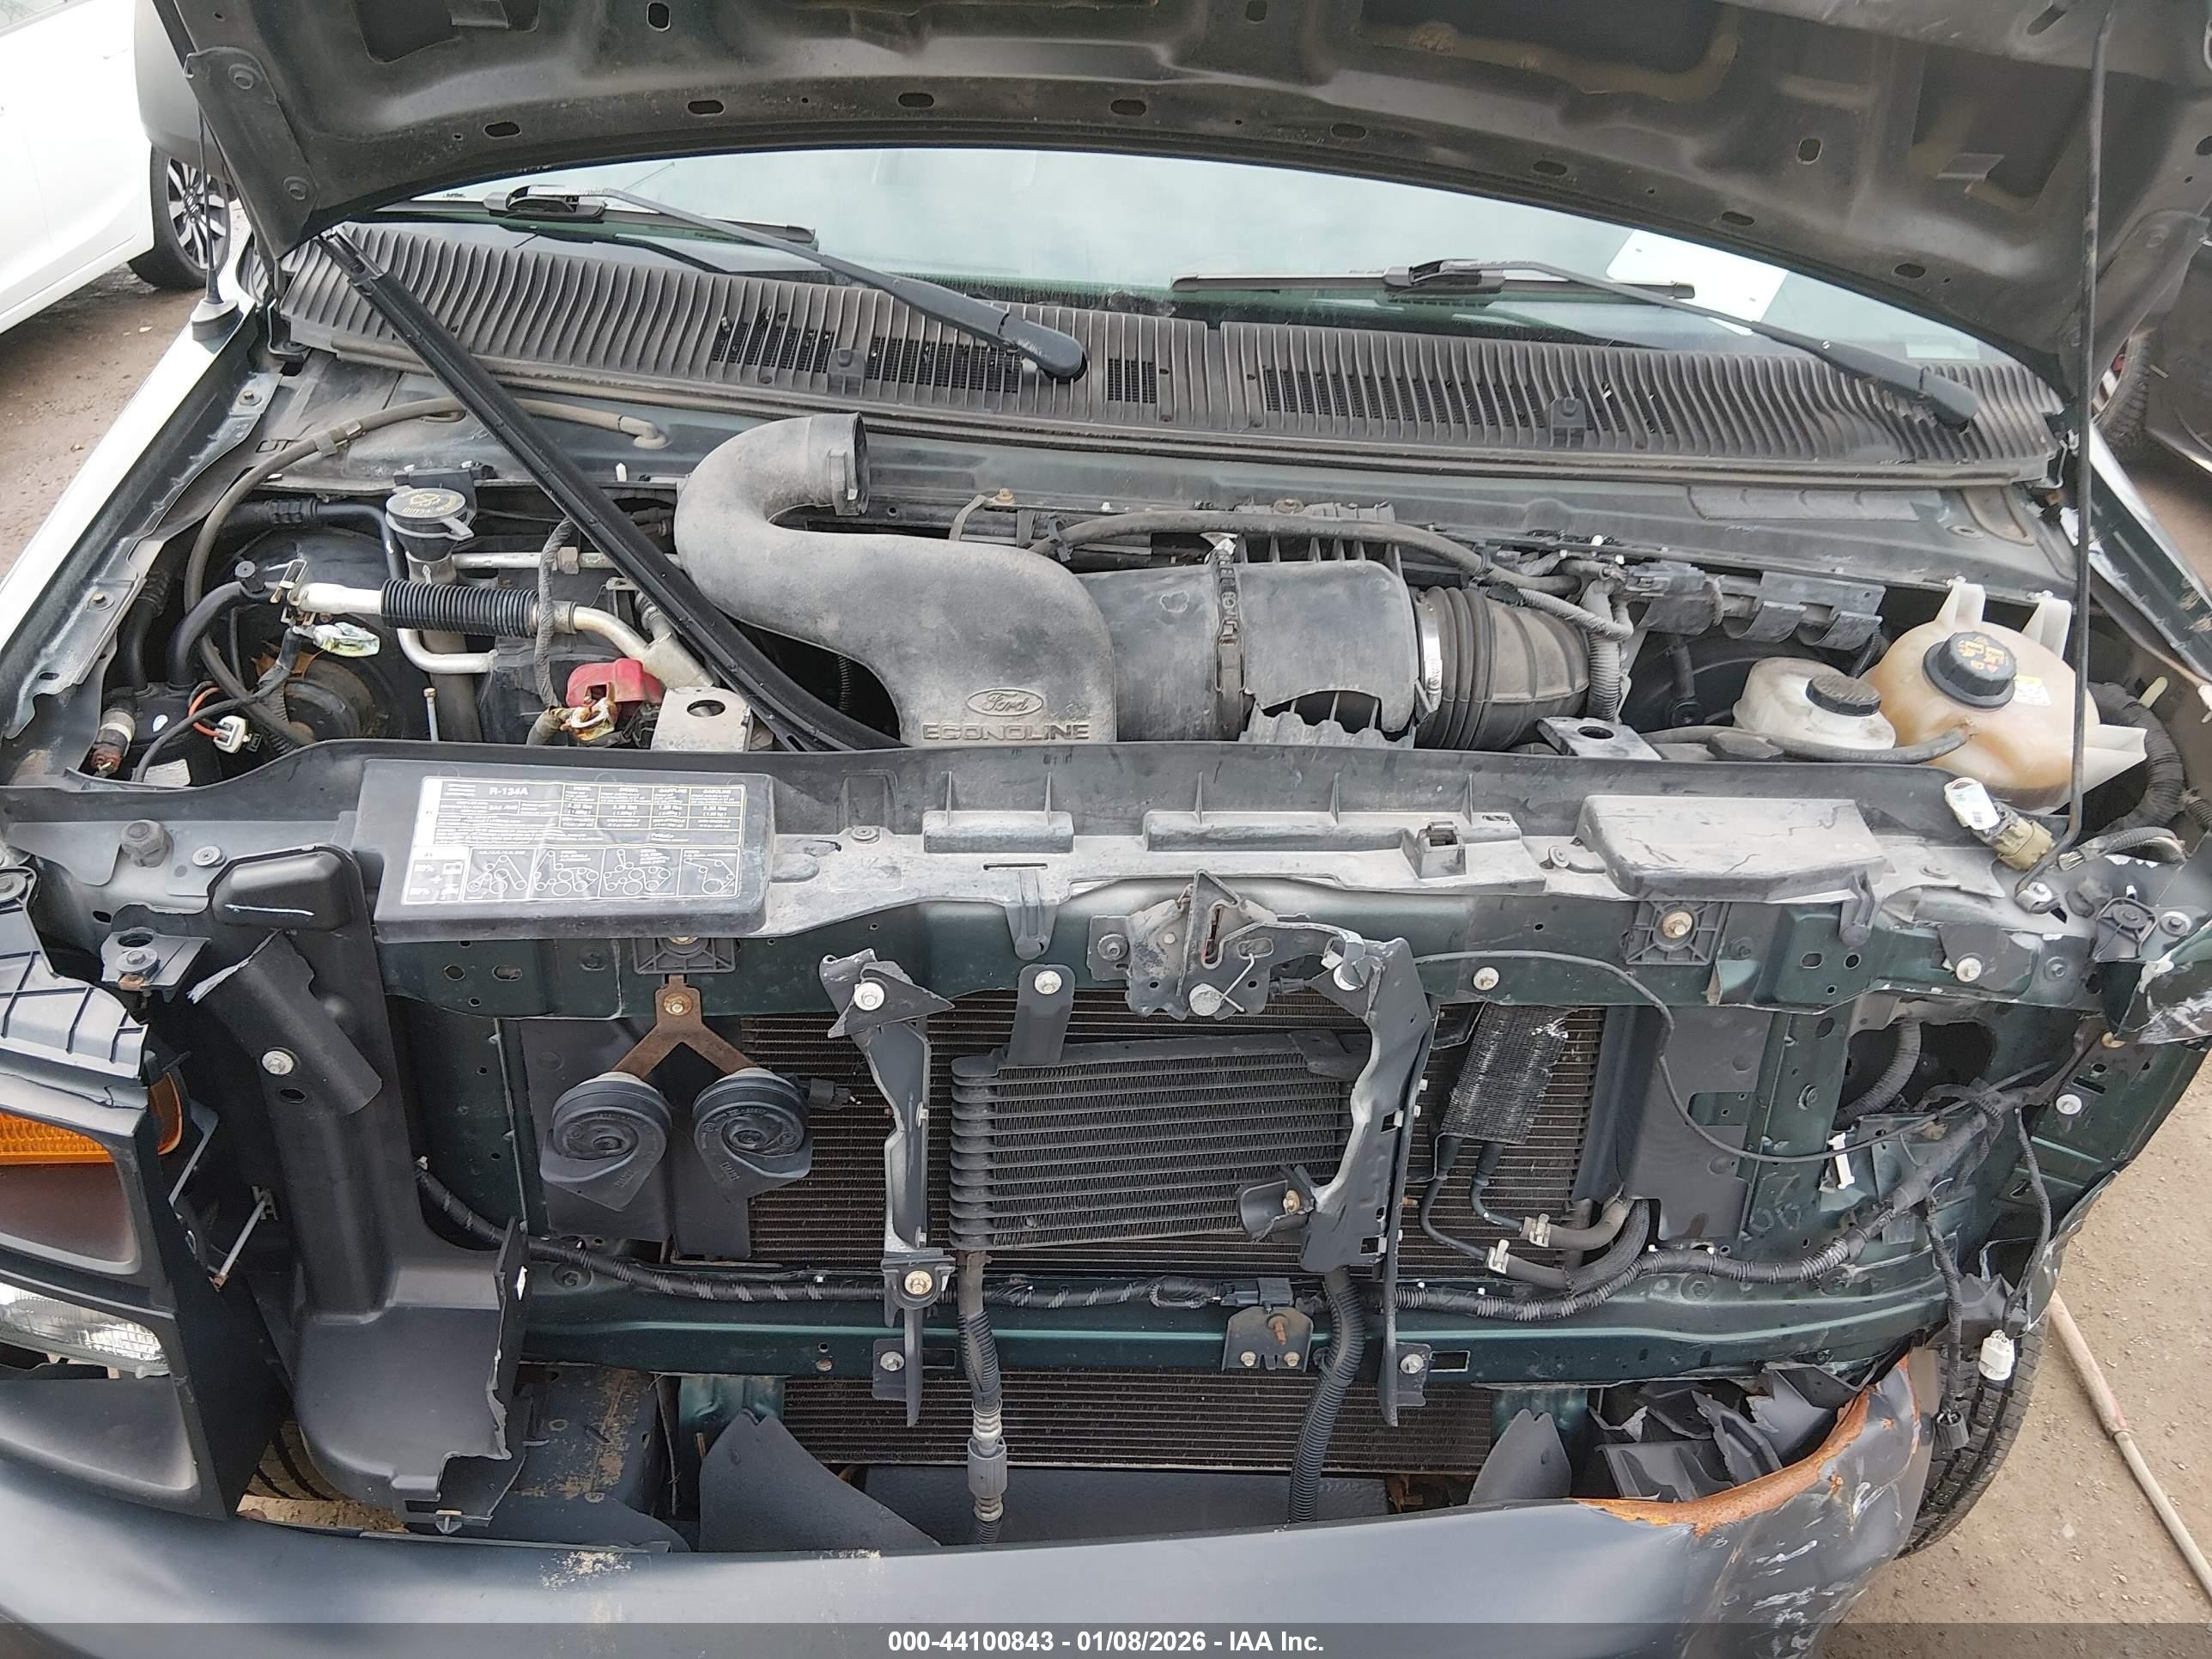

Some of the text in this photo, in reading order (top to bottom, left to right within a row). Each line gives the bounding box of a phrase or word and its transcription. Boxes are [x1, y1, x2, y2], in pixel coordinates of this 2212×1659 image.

[981, 691, 1030, 712] Ford
[922, 722, 1090, 741] ECONOLINE
[489, 787, 529, 796] R-134A
